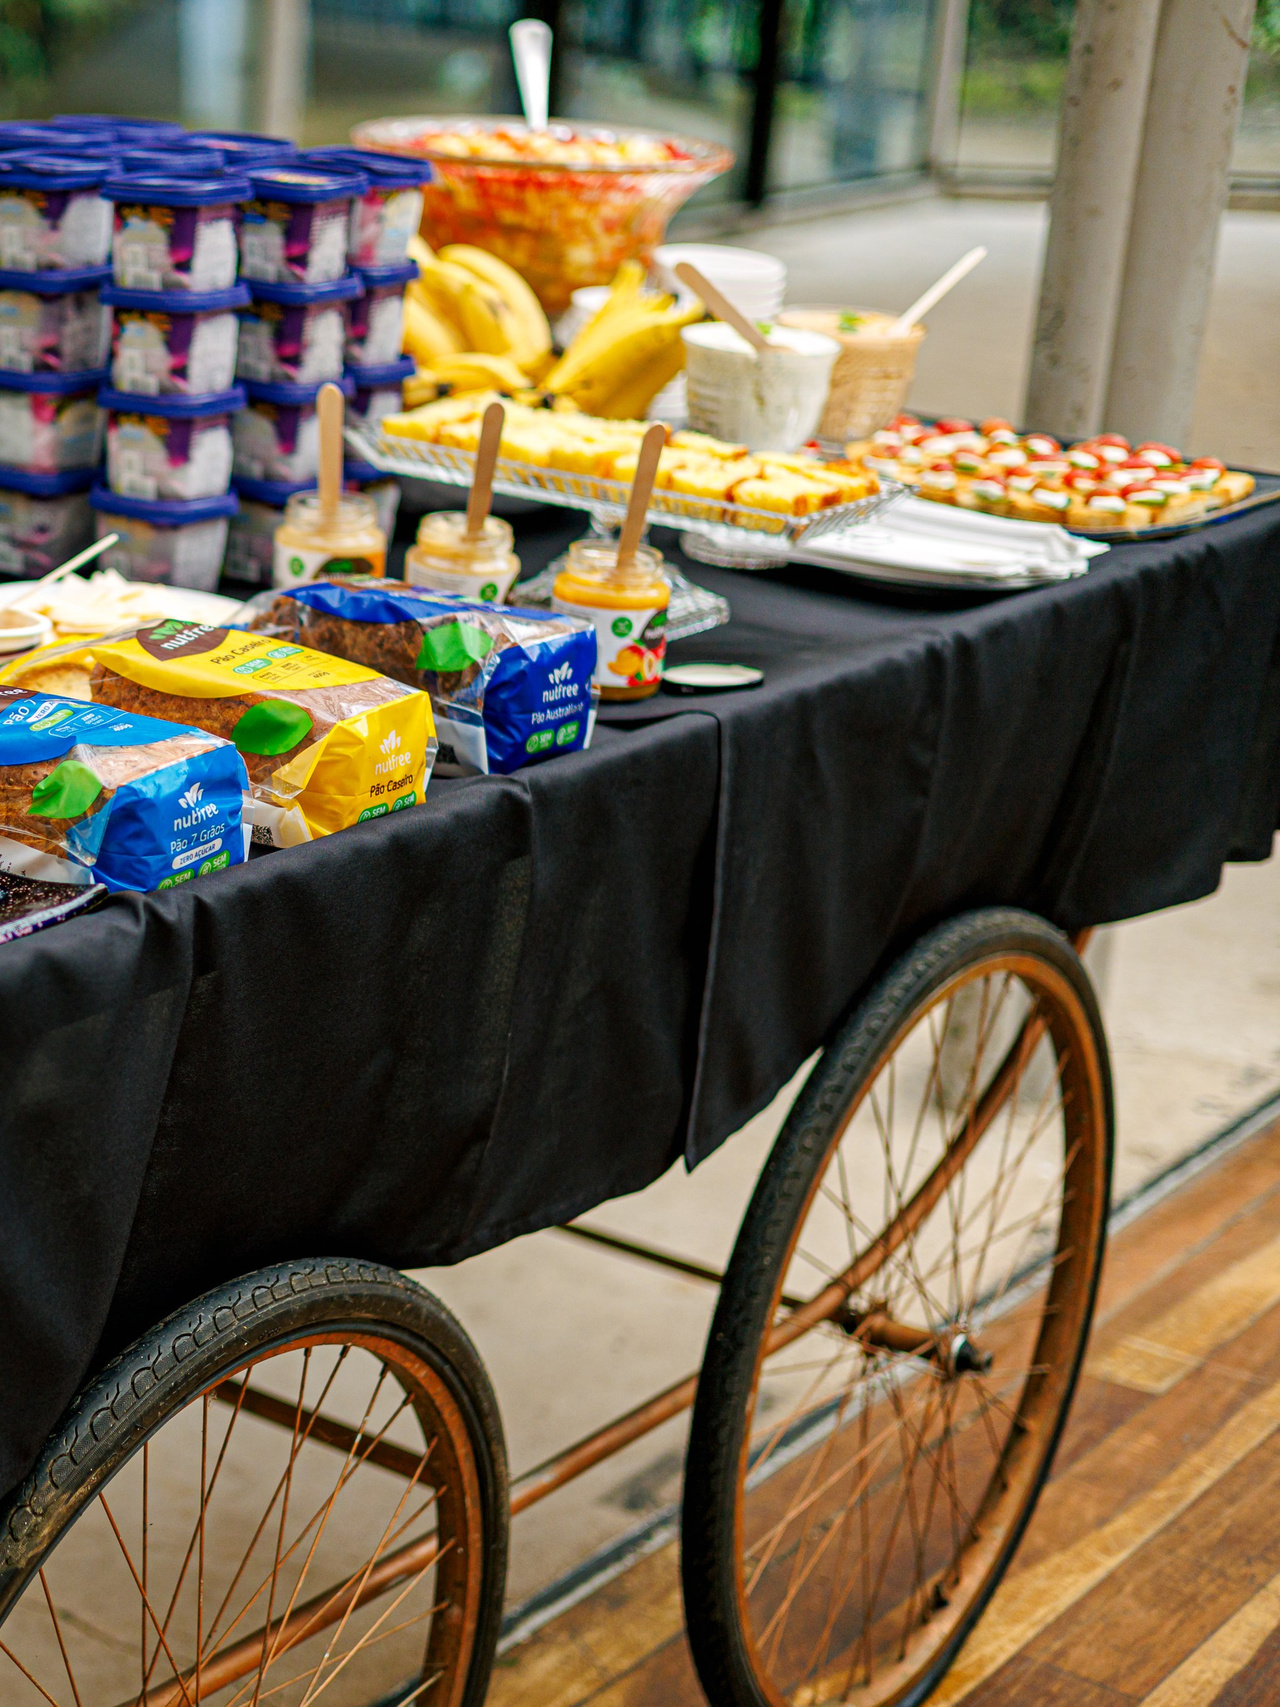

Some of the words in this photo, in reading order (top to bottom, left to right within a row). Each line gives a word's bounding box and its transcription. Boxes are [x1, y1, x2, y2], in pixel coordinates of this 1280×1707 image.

[160, 624, 215, 650] nutfre
[542, 683, 579, 703] nutfree
[2, 706, 30, 725] Pão
[531, 711, 545, 725] Pão
[374, 751, 412, 776] nutfree
[370, 784, 384, 797] Pão
[387, 775, 413, 792] Caseiro
[173, 803, 220, 832] nutfree
[371, 805, 387, 818] SEM
[170, 838, 189, 855] Pão
[191, 833, 198, 847] 7
[199, 823, 226, 843] Grãos
[178, 854, 195, 866] ZERO
[213, 853, 227, 868] SEM
